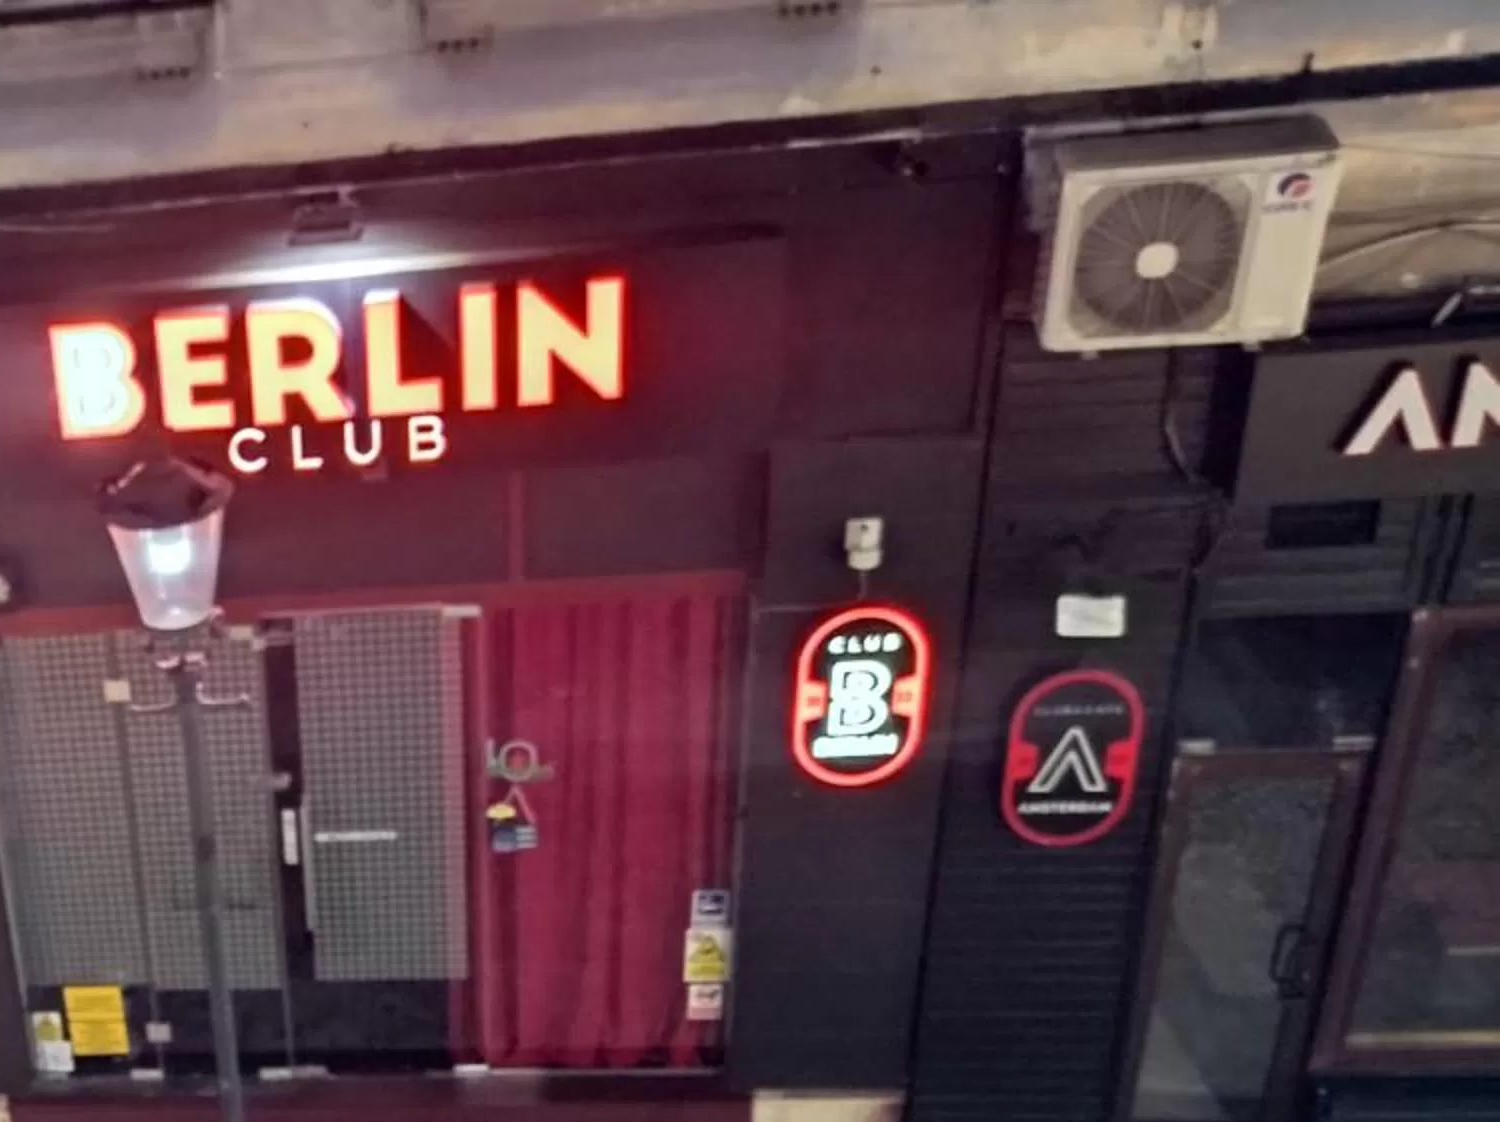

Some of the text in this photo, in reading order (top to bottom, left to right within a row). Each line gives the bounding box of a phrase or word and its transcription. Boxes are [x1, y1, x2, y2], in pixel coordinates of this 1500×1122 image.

[49, 277, 624, 439] BERLIN
[228, 415, 446, 472] CLUB
[828, 632, 903, 655] CLUB
[827, 660, 893, 737] B
